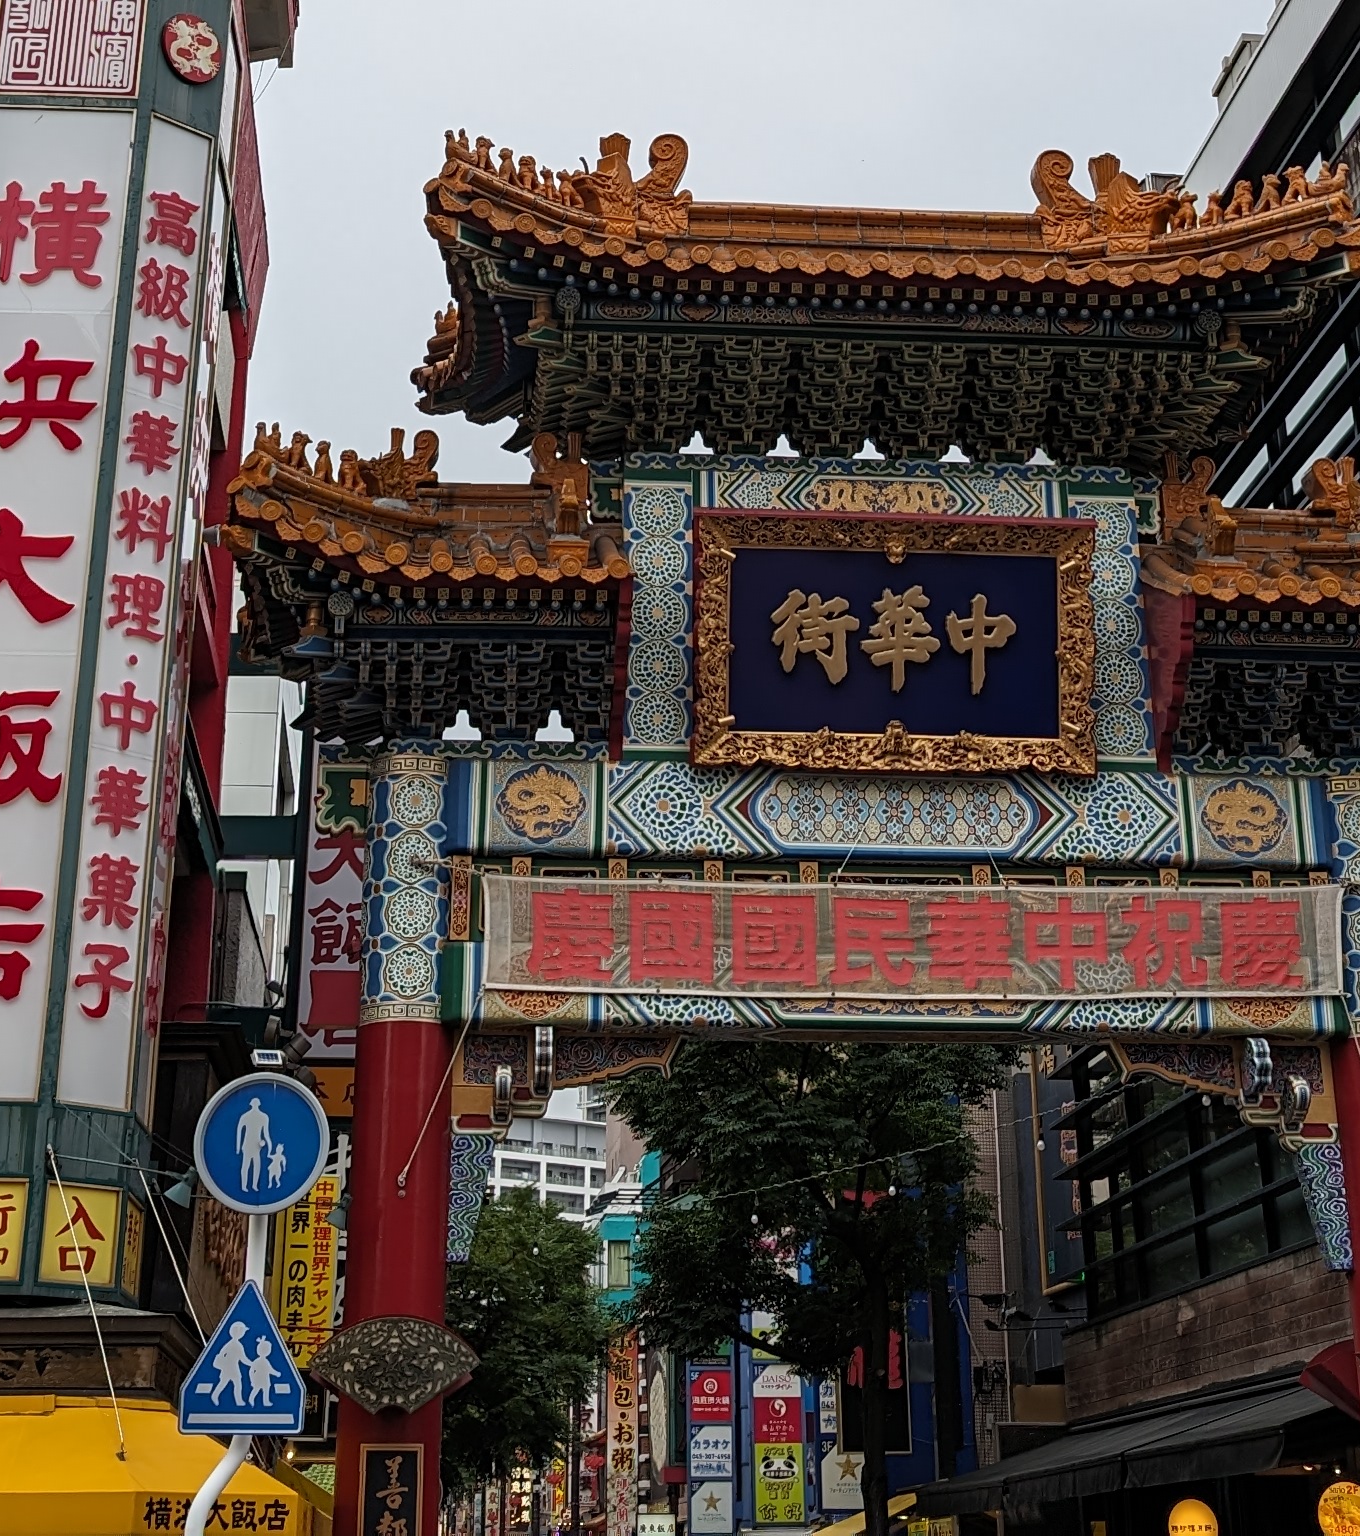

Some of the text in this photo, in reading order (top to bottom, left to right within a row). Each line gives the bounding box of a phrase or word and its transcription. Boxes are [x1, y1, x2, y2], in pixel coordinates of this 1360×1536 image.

[73, 189, 201, 1020] 高級中華料理・中華菓子
[770, 585, 1017, 696] 中華街
[55, 1195, 104, 1275] 入口
